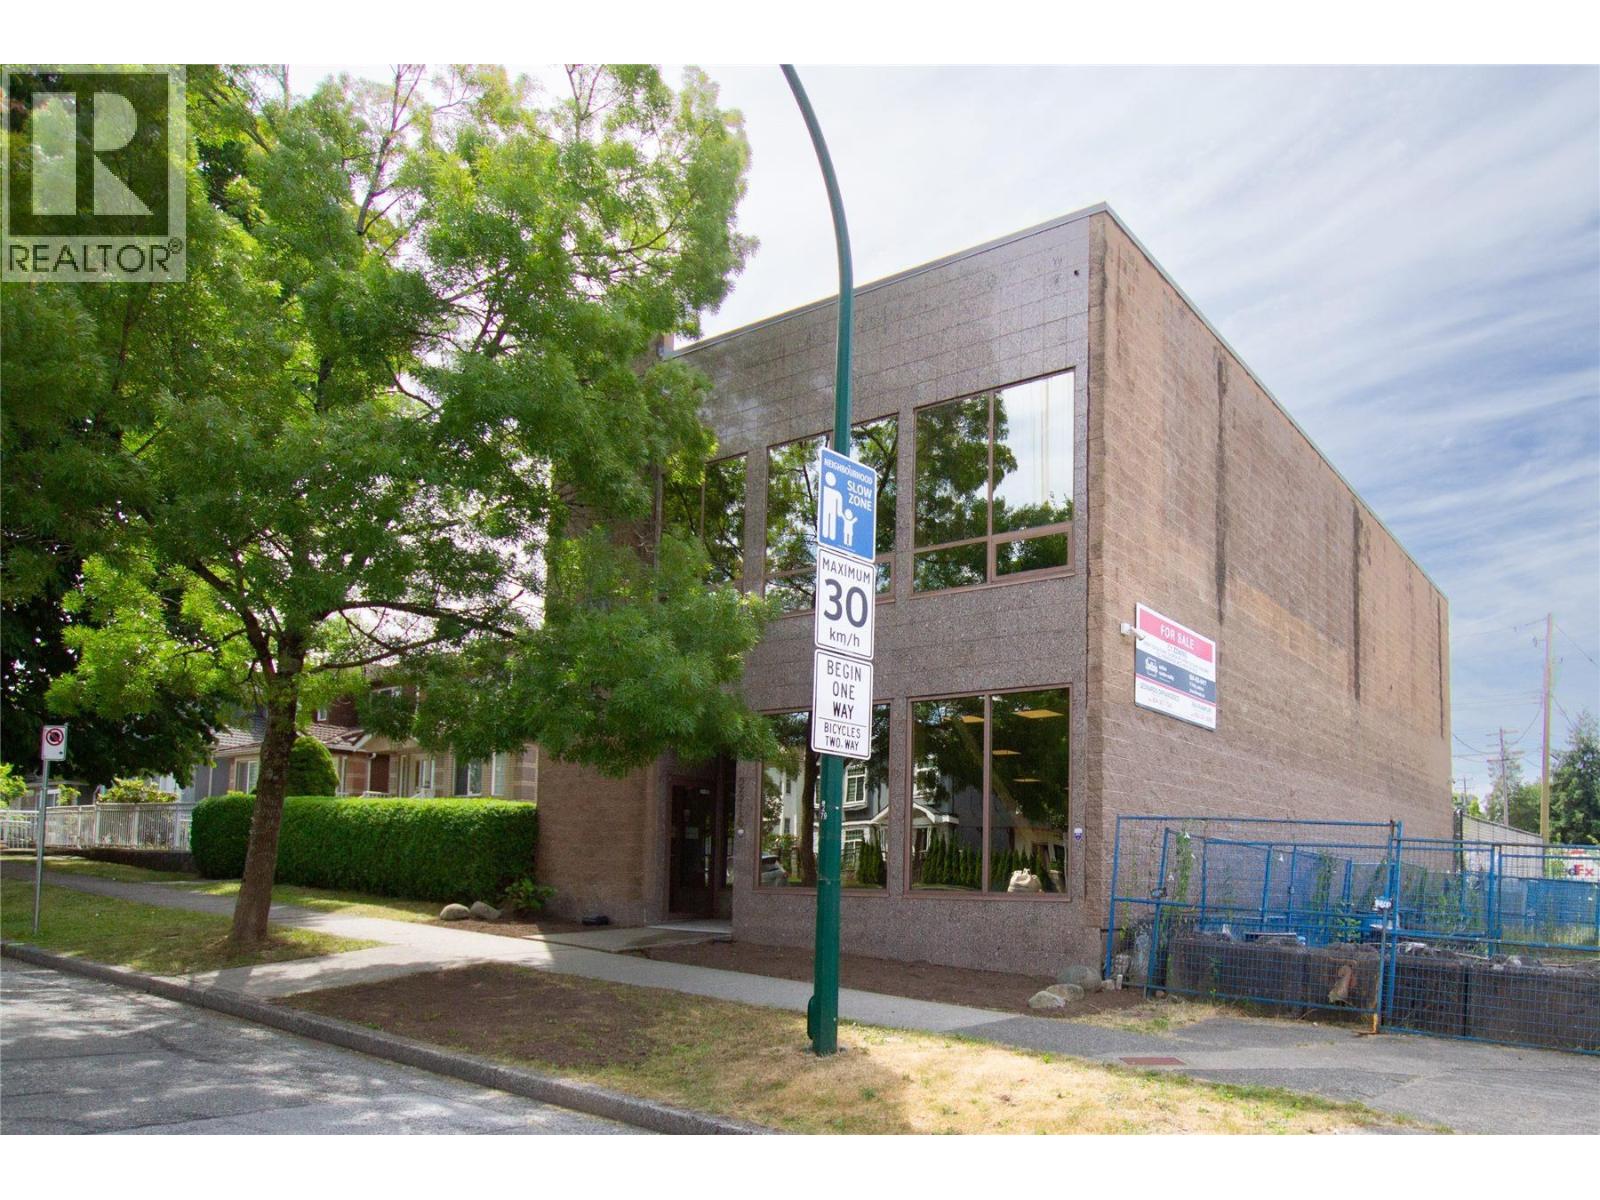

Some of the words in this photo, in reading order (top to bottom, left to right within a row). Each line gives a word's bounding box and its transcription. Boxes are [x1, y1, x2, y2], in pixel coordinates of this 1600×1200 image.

[823, 458, 873, 485] NEIGHBOURHOOD
[847, 480, 873, 499] SLOW
[848, 493, 872, 512] ZONE
[822, 557, 871, 584] MAXIMUM
[823, 578, 868, 628] 30
[829, 627, 860, 648] km/h
[1160, 623, 1176, 641] FOR
[1177, 631, 1195, 650] SALE
[827, 660, 862, 682] BEGIN
[832, 681, 855, 700] ONE
[832, 701, 854, 720] WAY
[824, 722, 861, 739] BICYCLES
[825, 736, 841, 748] TWO
[845, 739, 860, 751] WAY
